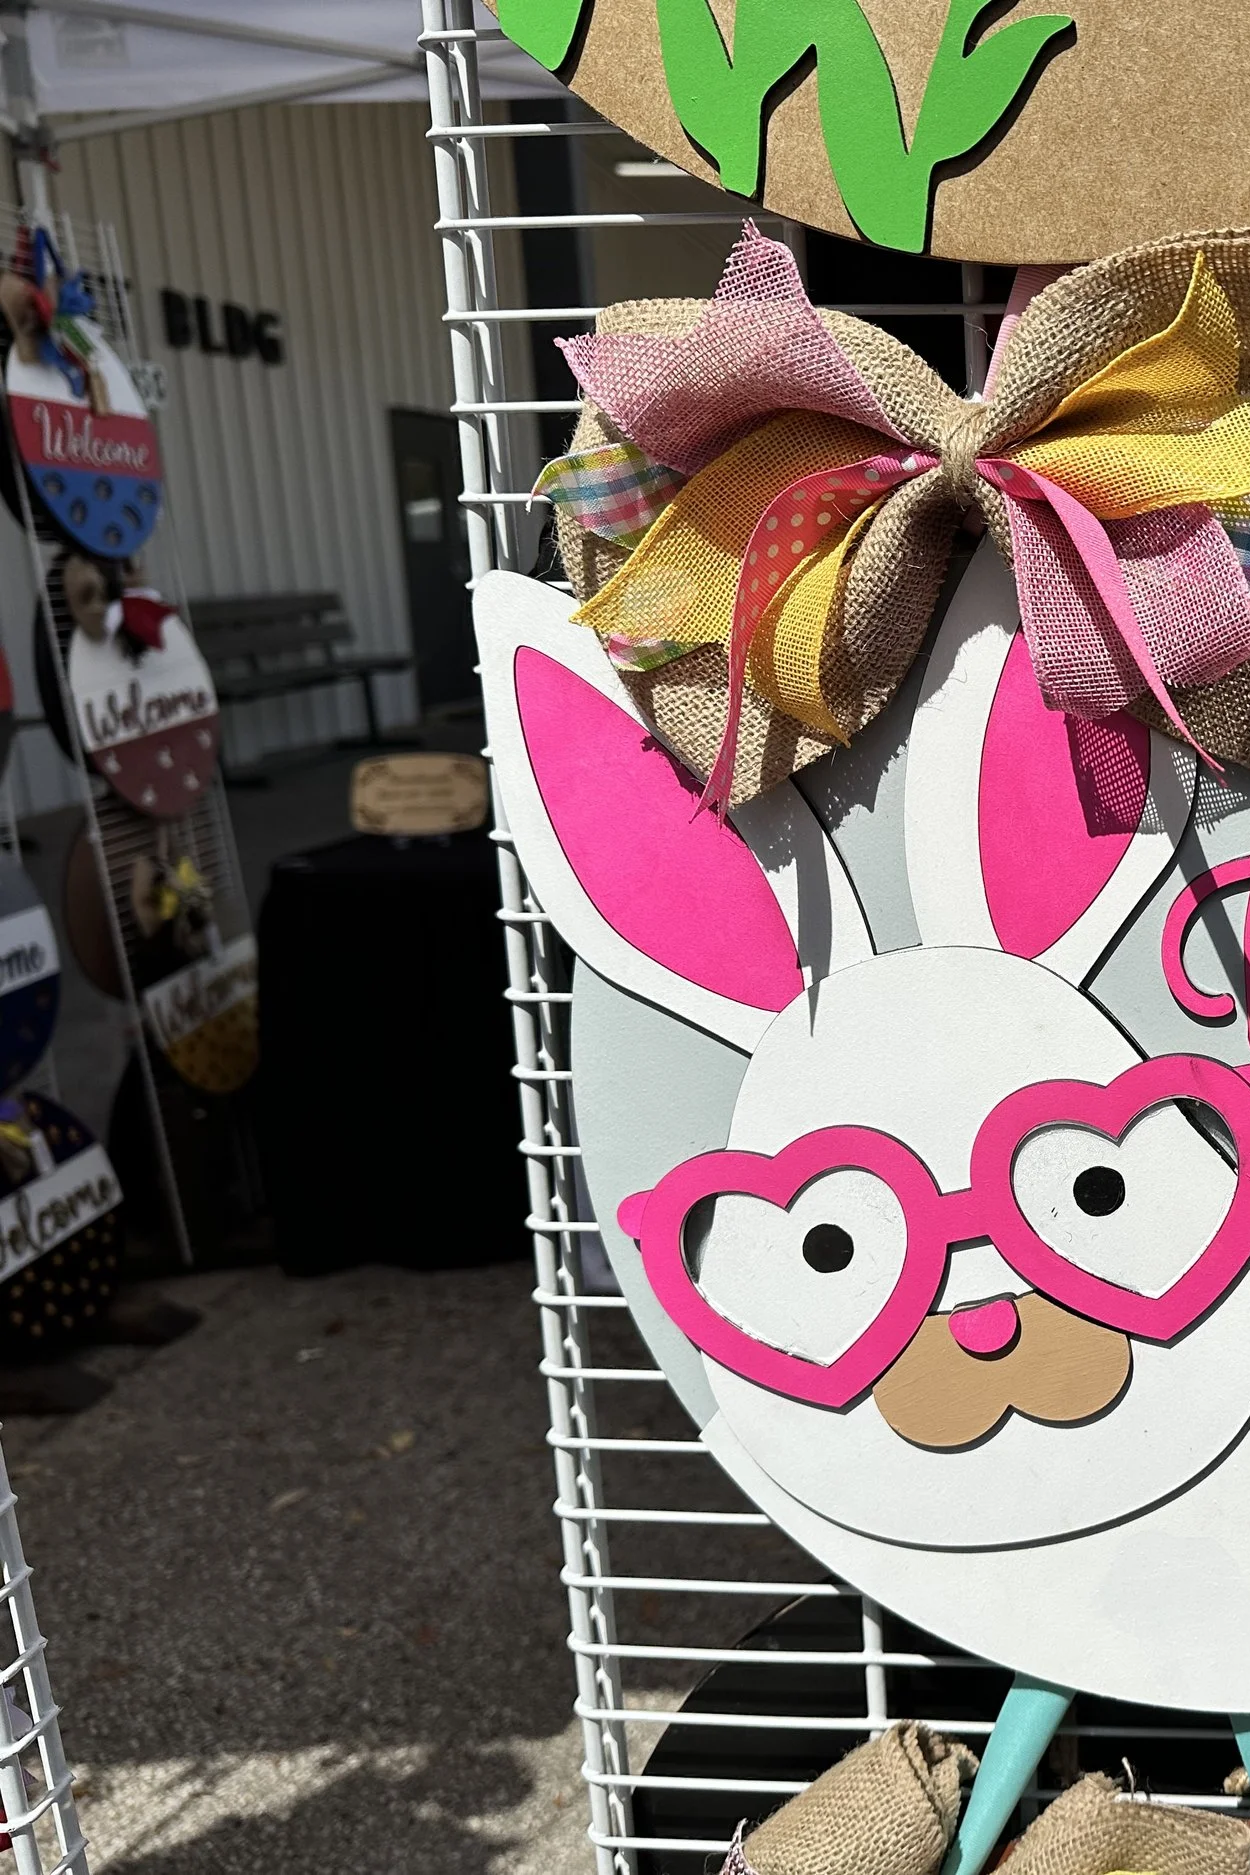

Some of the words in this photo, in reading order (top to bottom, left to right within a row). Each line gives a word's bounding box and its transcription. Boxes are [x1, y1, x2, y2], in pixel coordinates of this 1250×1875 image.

[160, 287, 282, 367] BLDG
[32, 402, 149, 472] Welcome
[83, 679, 208, 741] Welcome
[0, 1175, 113, 1266] elcome
